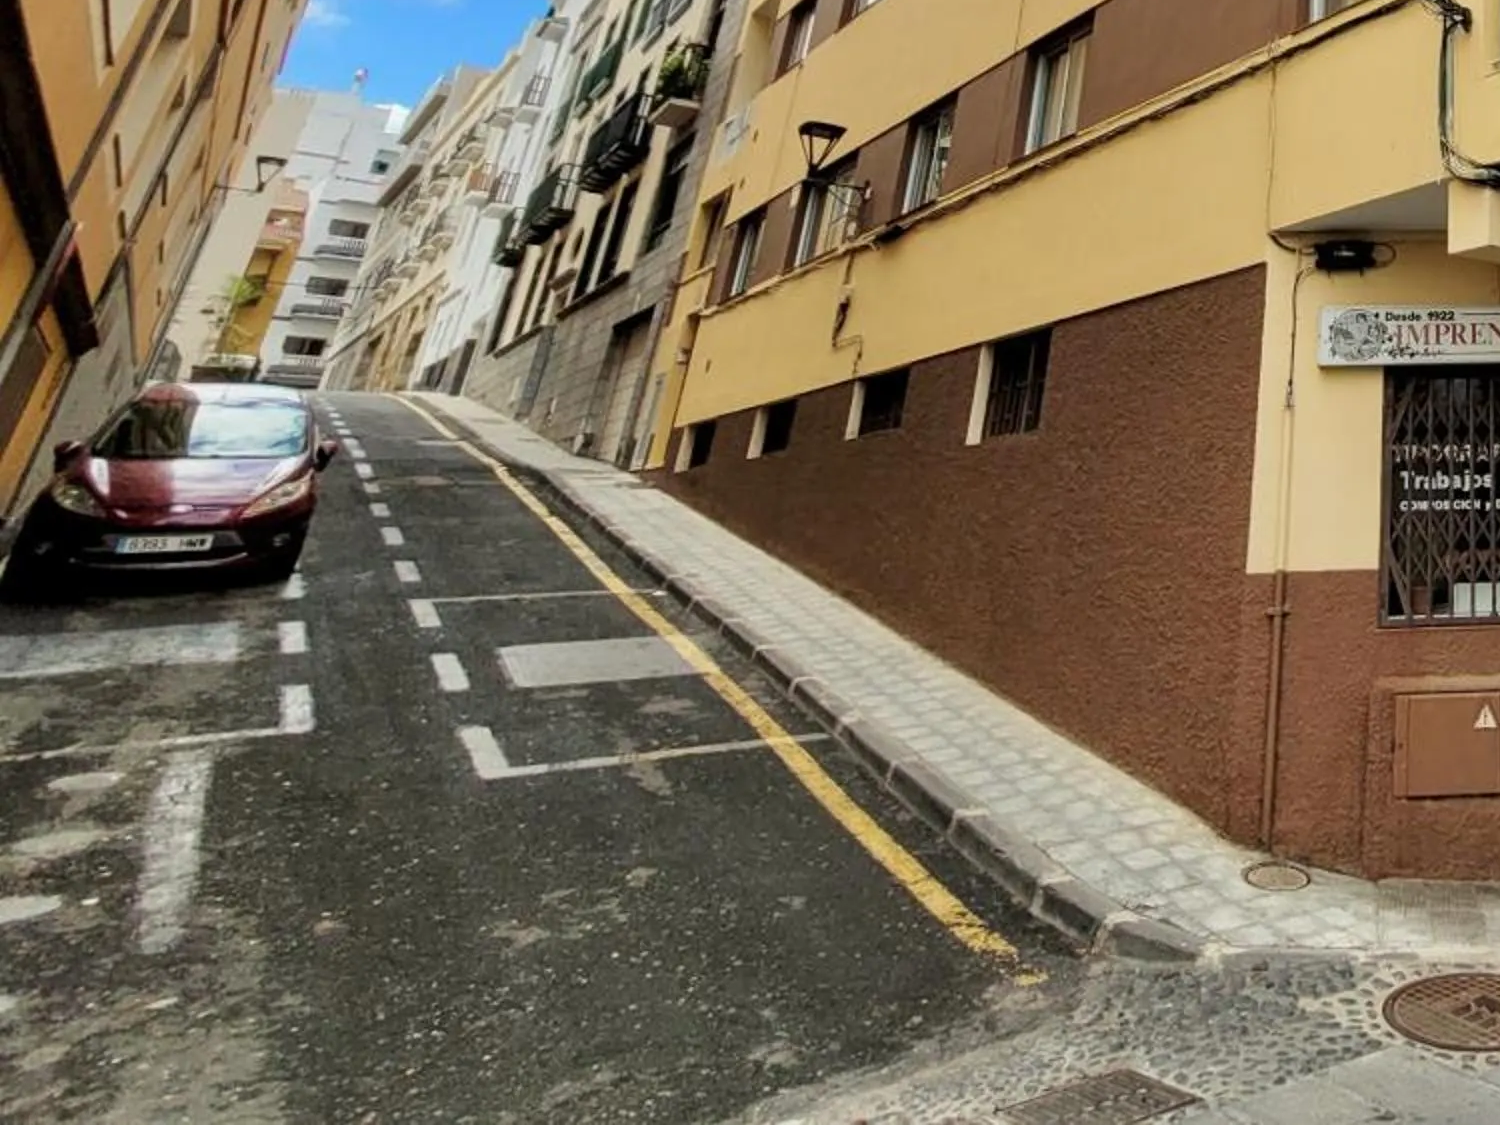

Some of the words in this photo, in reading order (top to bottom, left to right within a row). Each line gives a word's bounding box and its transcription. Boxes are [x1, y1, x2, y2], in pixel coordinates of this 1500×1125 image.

[1385, 312, 1422, 322] Desde
[1427, 310, 1456, 322] 1922
[1399, 469, 1493, 492] Trabajos
